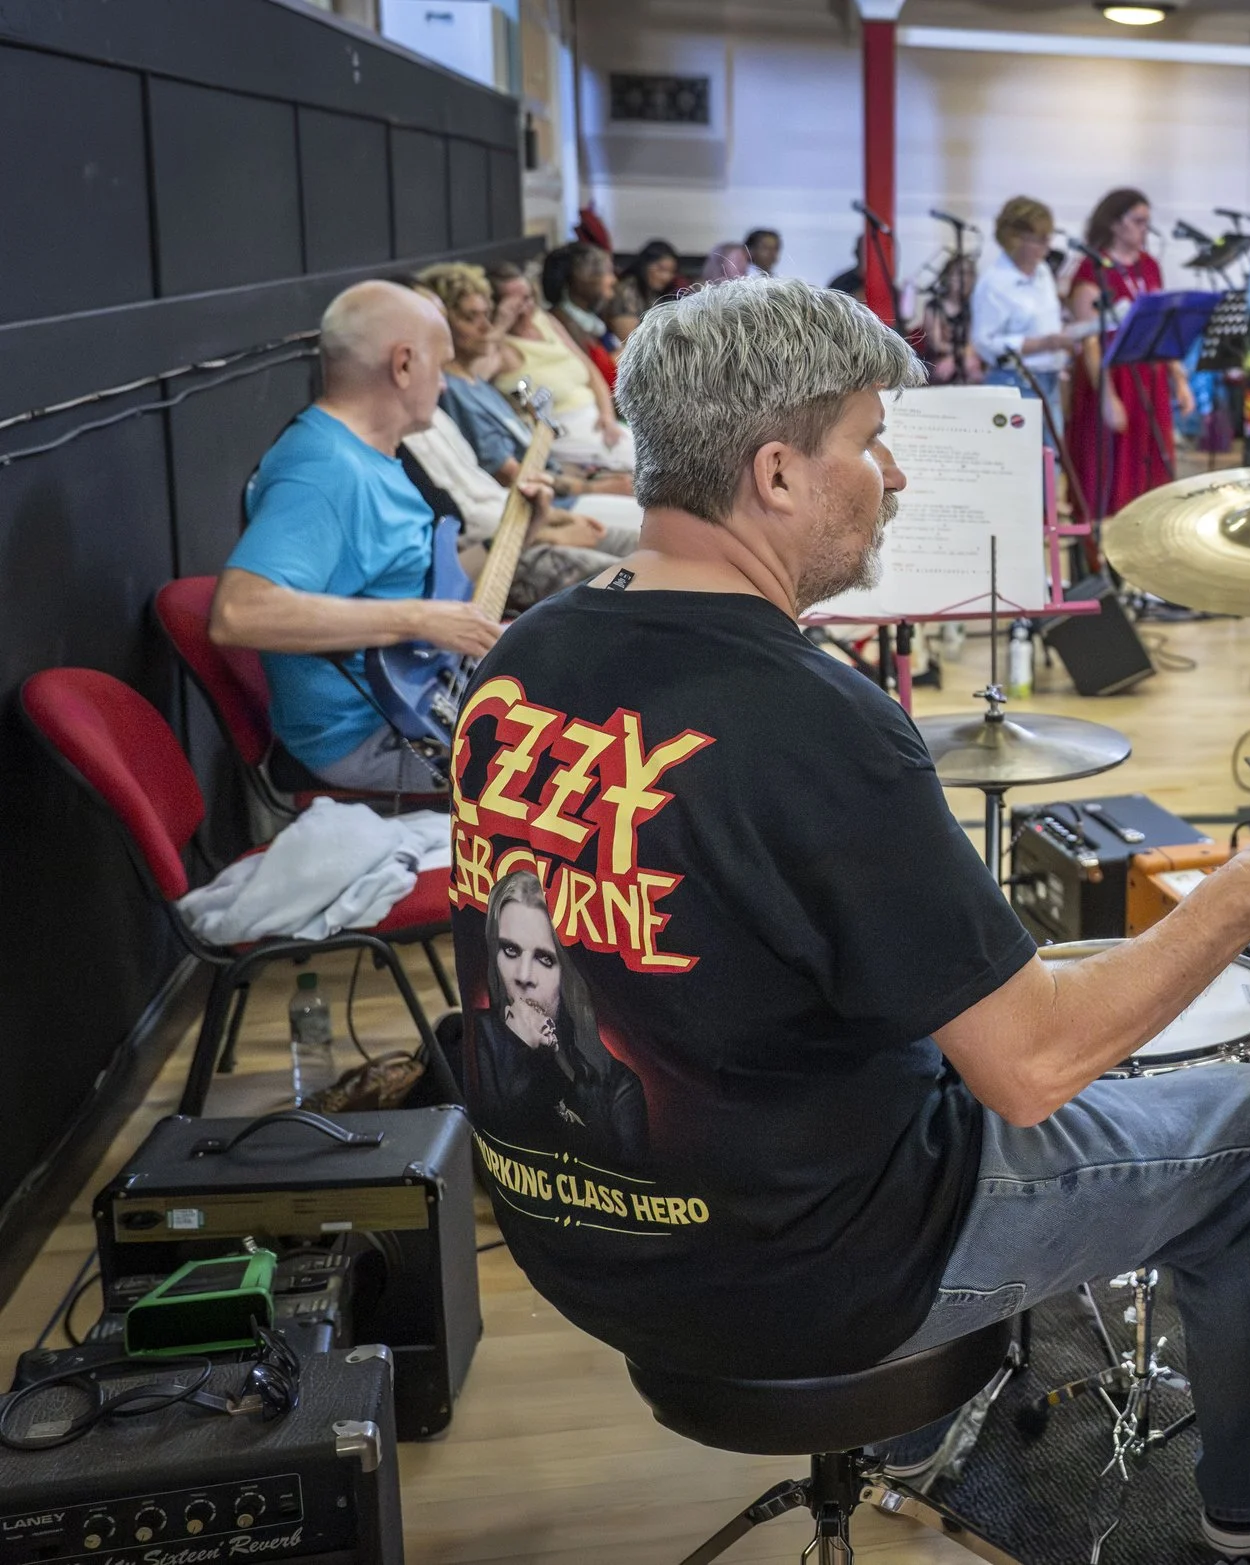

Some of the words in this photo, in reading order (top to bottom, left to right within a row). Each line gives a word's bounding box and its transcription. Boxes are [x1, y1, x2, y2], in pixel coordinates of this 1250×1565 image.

[451, 678, 707, 875] OZZY
[449, 815, 691, 968] SBURNE
[556, 1173, 628, 1218] CLASS
[630, 1193, 710, 1225] HERO
[2, 1511, 66, 1531] LANEY
[228, 1526, 304, 1556] Reverb
